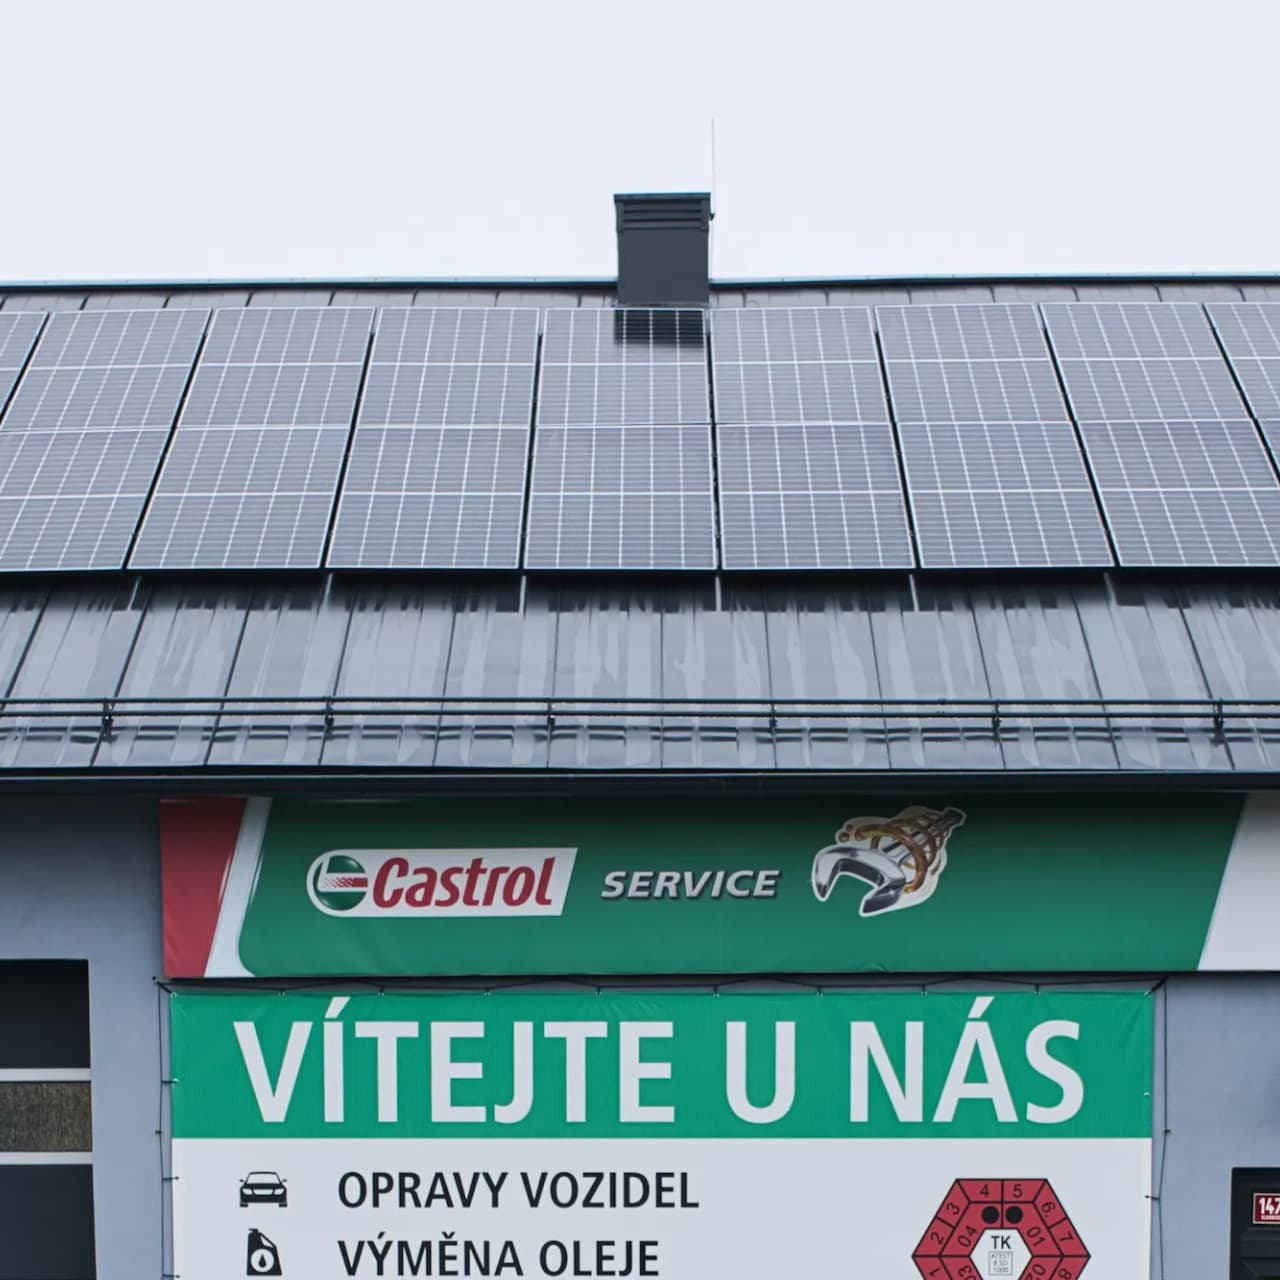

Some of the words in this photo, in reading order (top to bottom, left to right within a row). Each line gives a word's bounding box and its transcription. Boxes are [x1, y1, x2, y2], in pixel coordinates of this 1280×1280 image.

[372, 856, 556, 909] Castrol
[601, 869, 780, 899] SERVICE
[233, 996, 676, 1125] VÍTEJTE
[725, 1020, 795, 1125] U
[850, 996, 1085, 1125] NÁS
[337, 1171, 509, 1208] OPRAVY
[520, 1171, 700, 1208] VOZIDEL
[980, 1184, 990, 1197] 4
[1013, 1184, 1023, 1198] 5
[946, 1202, 960, 1215] 3
[930, 1232, 944, 1245] 2
[958, 1225, 977, 1247] 04
[991, 1236, 1012, 1249] TK
[1027, 1227, 1045, 1246] 01
[1060, 1232, 1073, 1242] 7
[337, 1232, 524, 1277] VÝMĚNA
[539, 1240, 660, 1277] OLEJE
[929, 1267, 941, 1277] 1
[1058, 1269, 1072, 1280] 8
